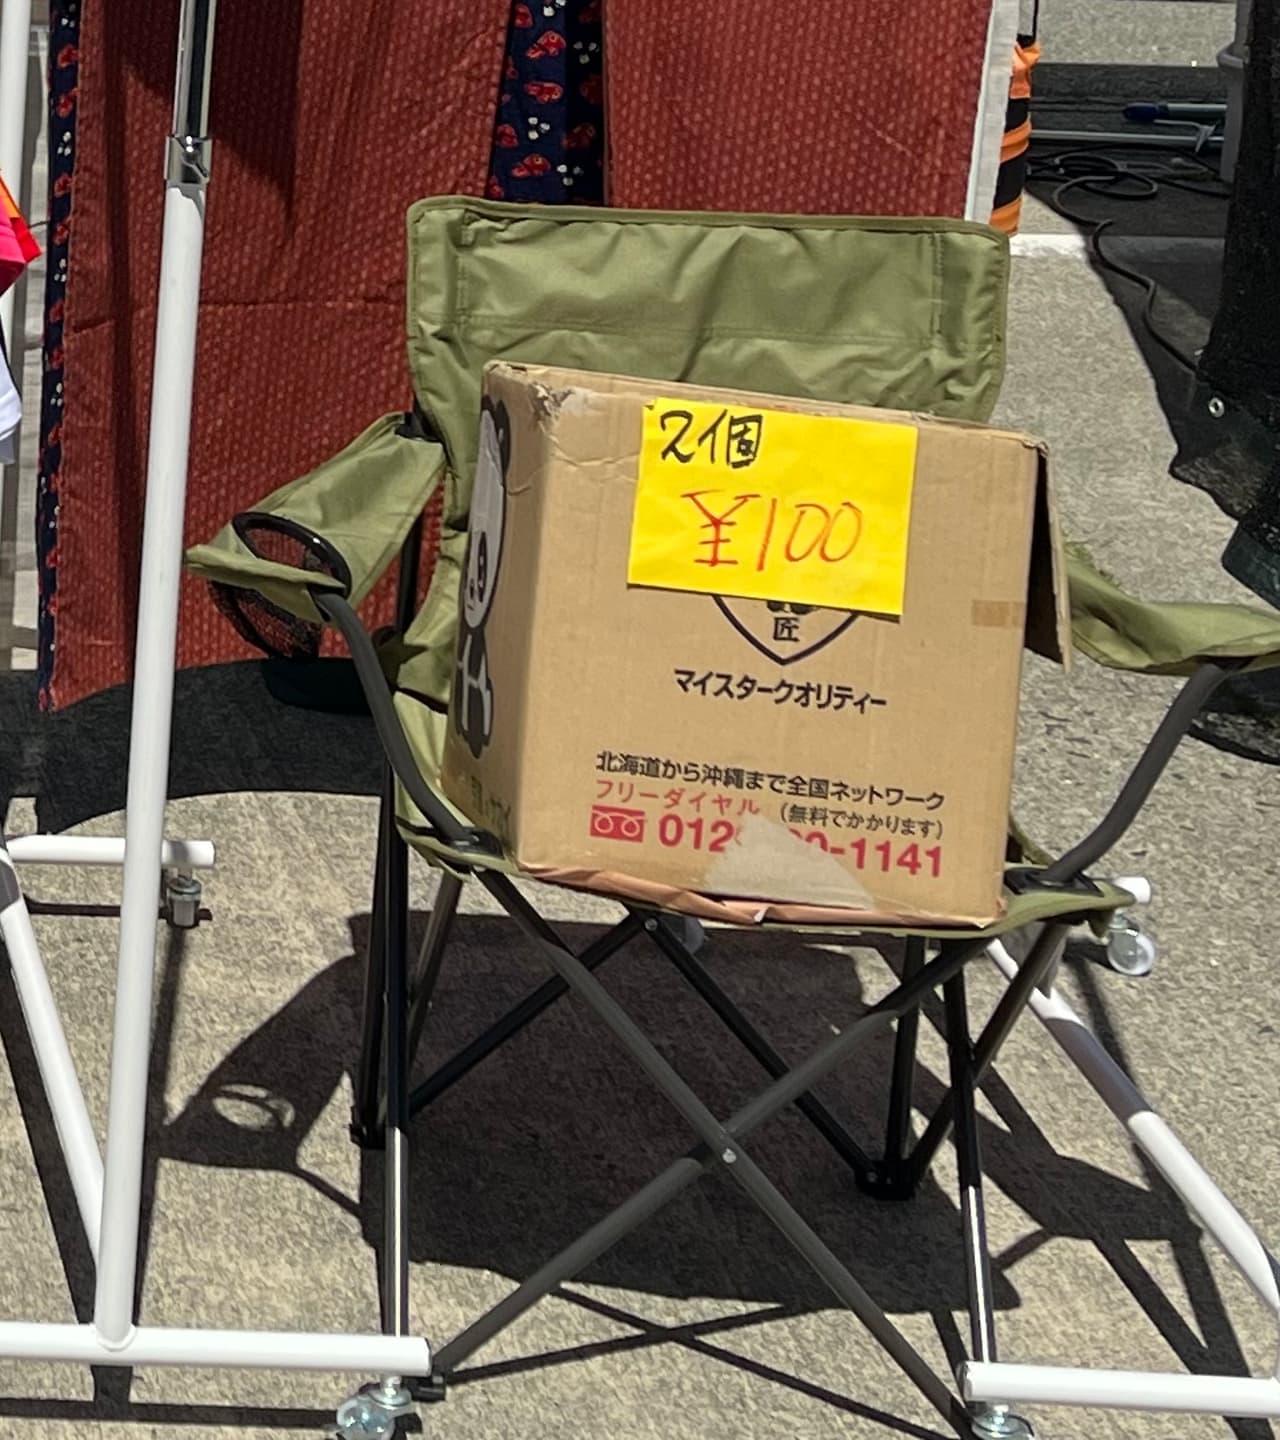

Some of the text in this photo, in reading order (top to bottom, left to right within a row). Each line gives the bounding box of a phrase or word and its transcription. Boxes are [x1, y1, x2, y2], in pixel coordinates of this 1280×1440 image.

[660, 409, 763, 469] 2個
[681, 490, 862, 572] ¥100
[772, 616, 800, 642] 匠
[674, 668, 887, 715] マイスタークオリティー
[595, 751, 945, 812] 北海道から沖縄まで全国ネットワーク
[595, 779, 760, 816] フリーダイヤル
